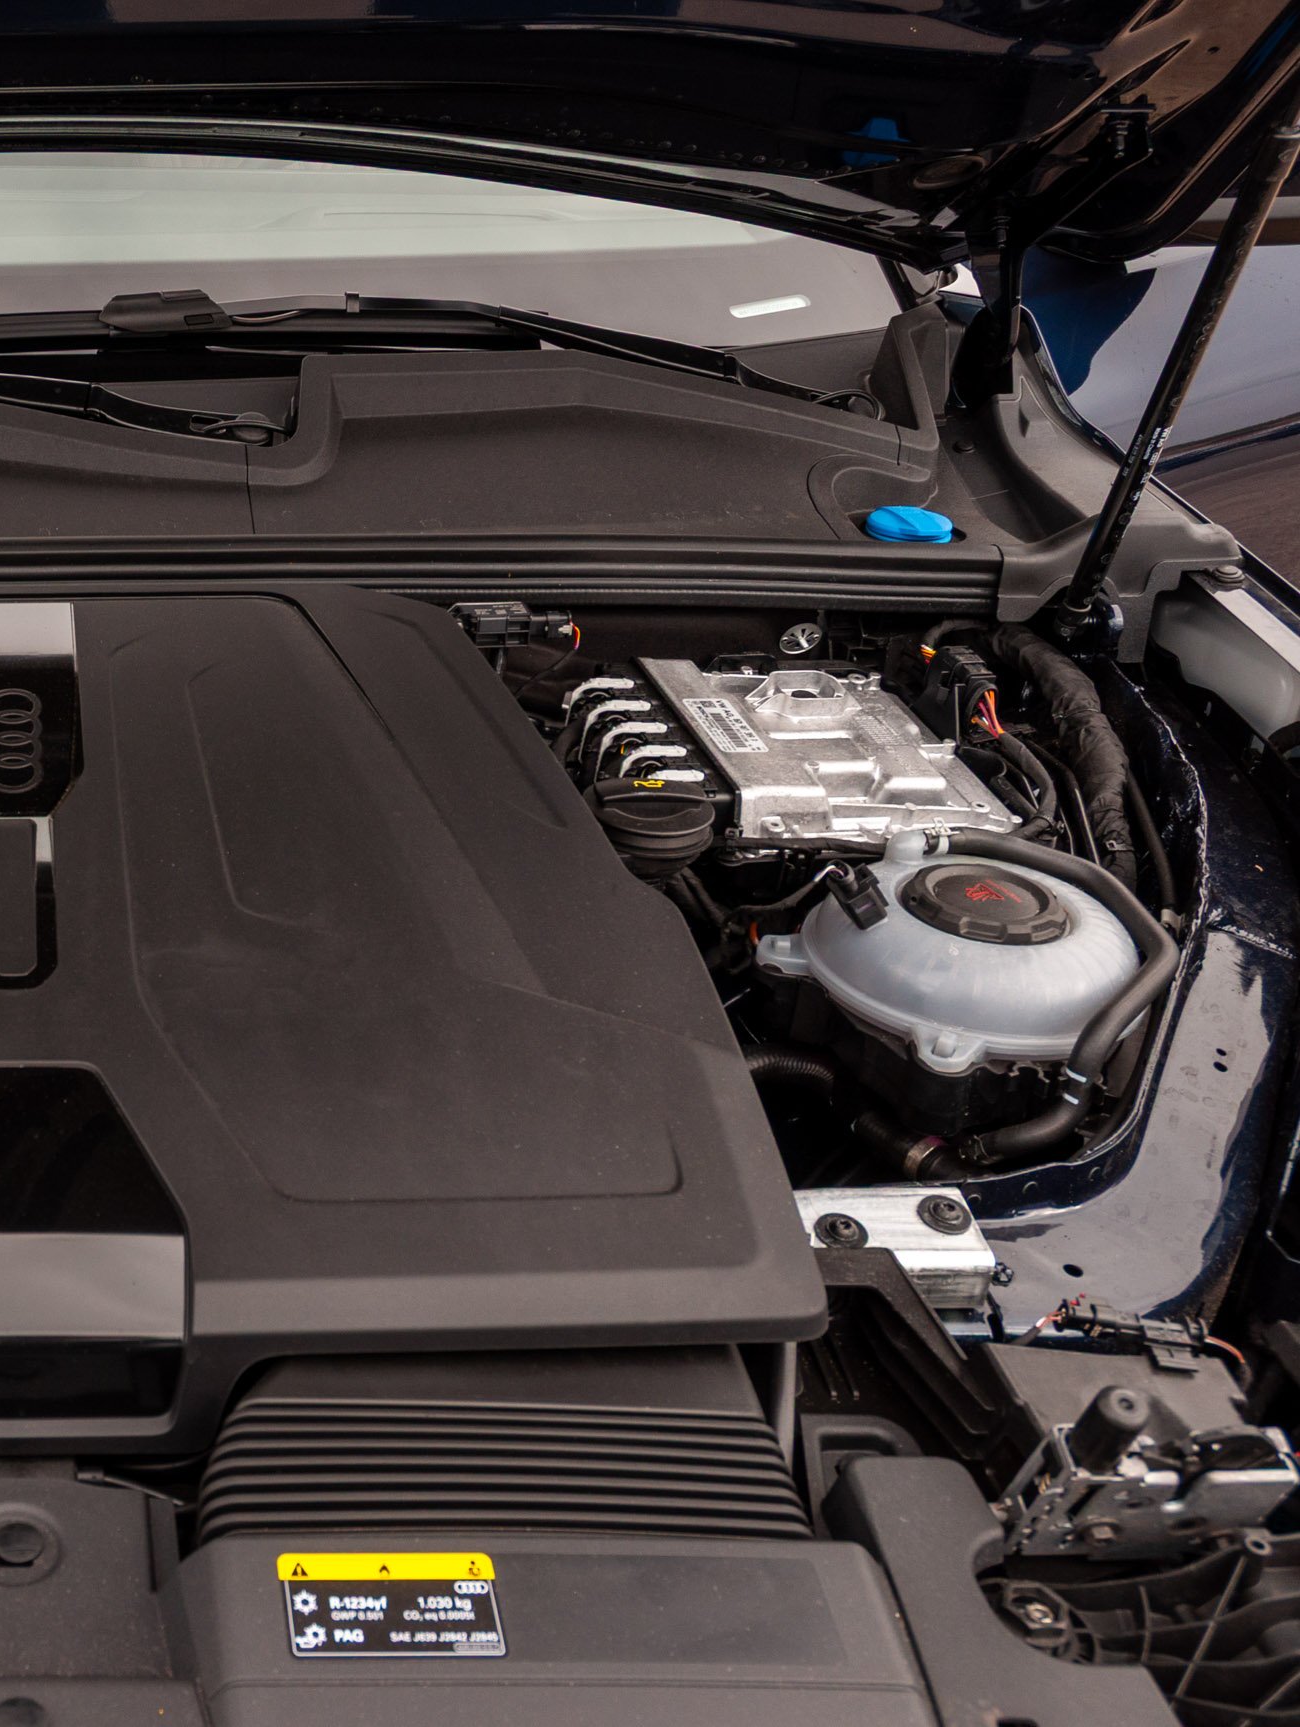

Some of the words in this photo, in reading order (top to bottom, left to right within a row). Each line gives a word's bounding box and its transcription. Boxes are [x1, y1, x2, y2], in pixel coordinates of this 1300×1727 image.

[716, 700, 728, 709] VW
[328, 1596, 388, 1611] R-1234yf
[417, 1596, 452, 1609] 1.030
[454, 1596, 472, 1611] kg
[332, 1628, 365, 1643] PAG
[389, 1631, 412, 1643] SAE
